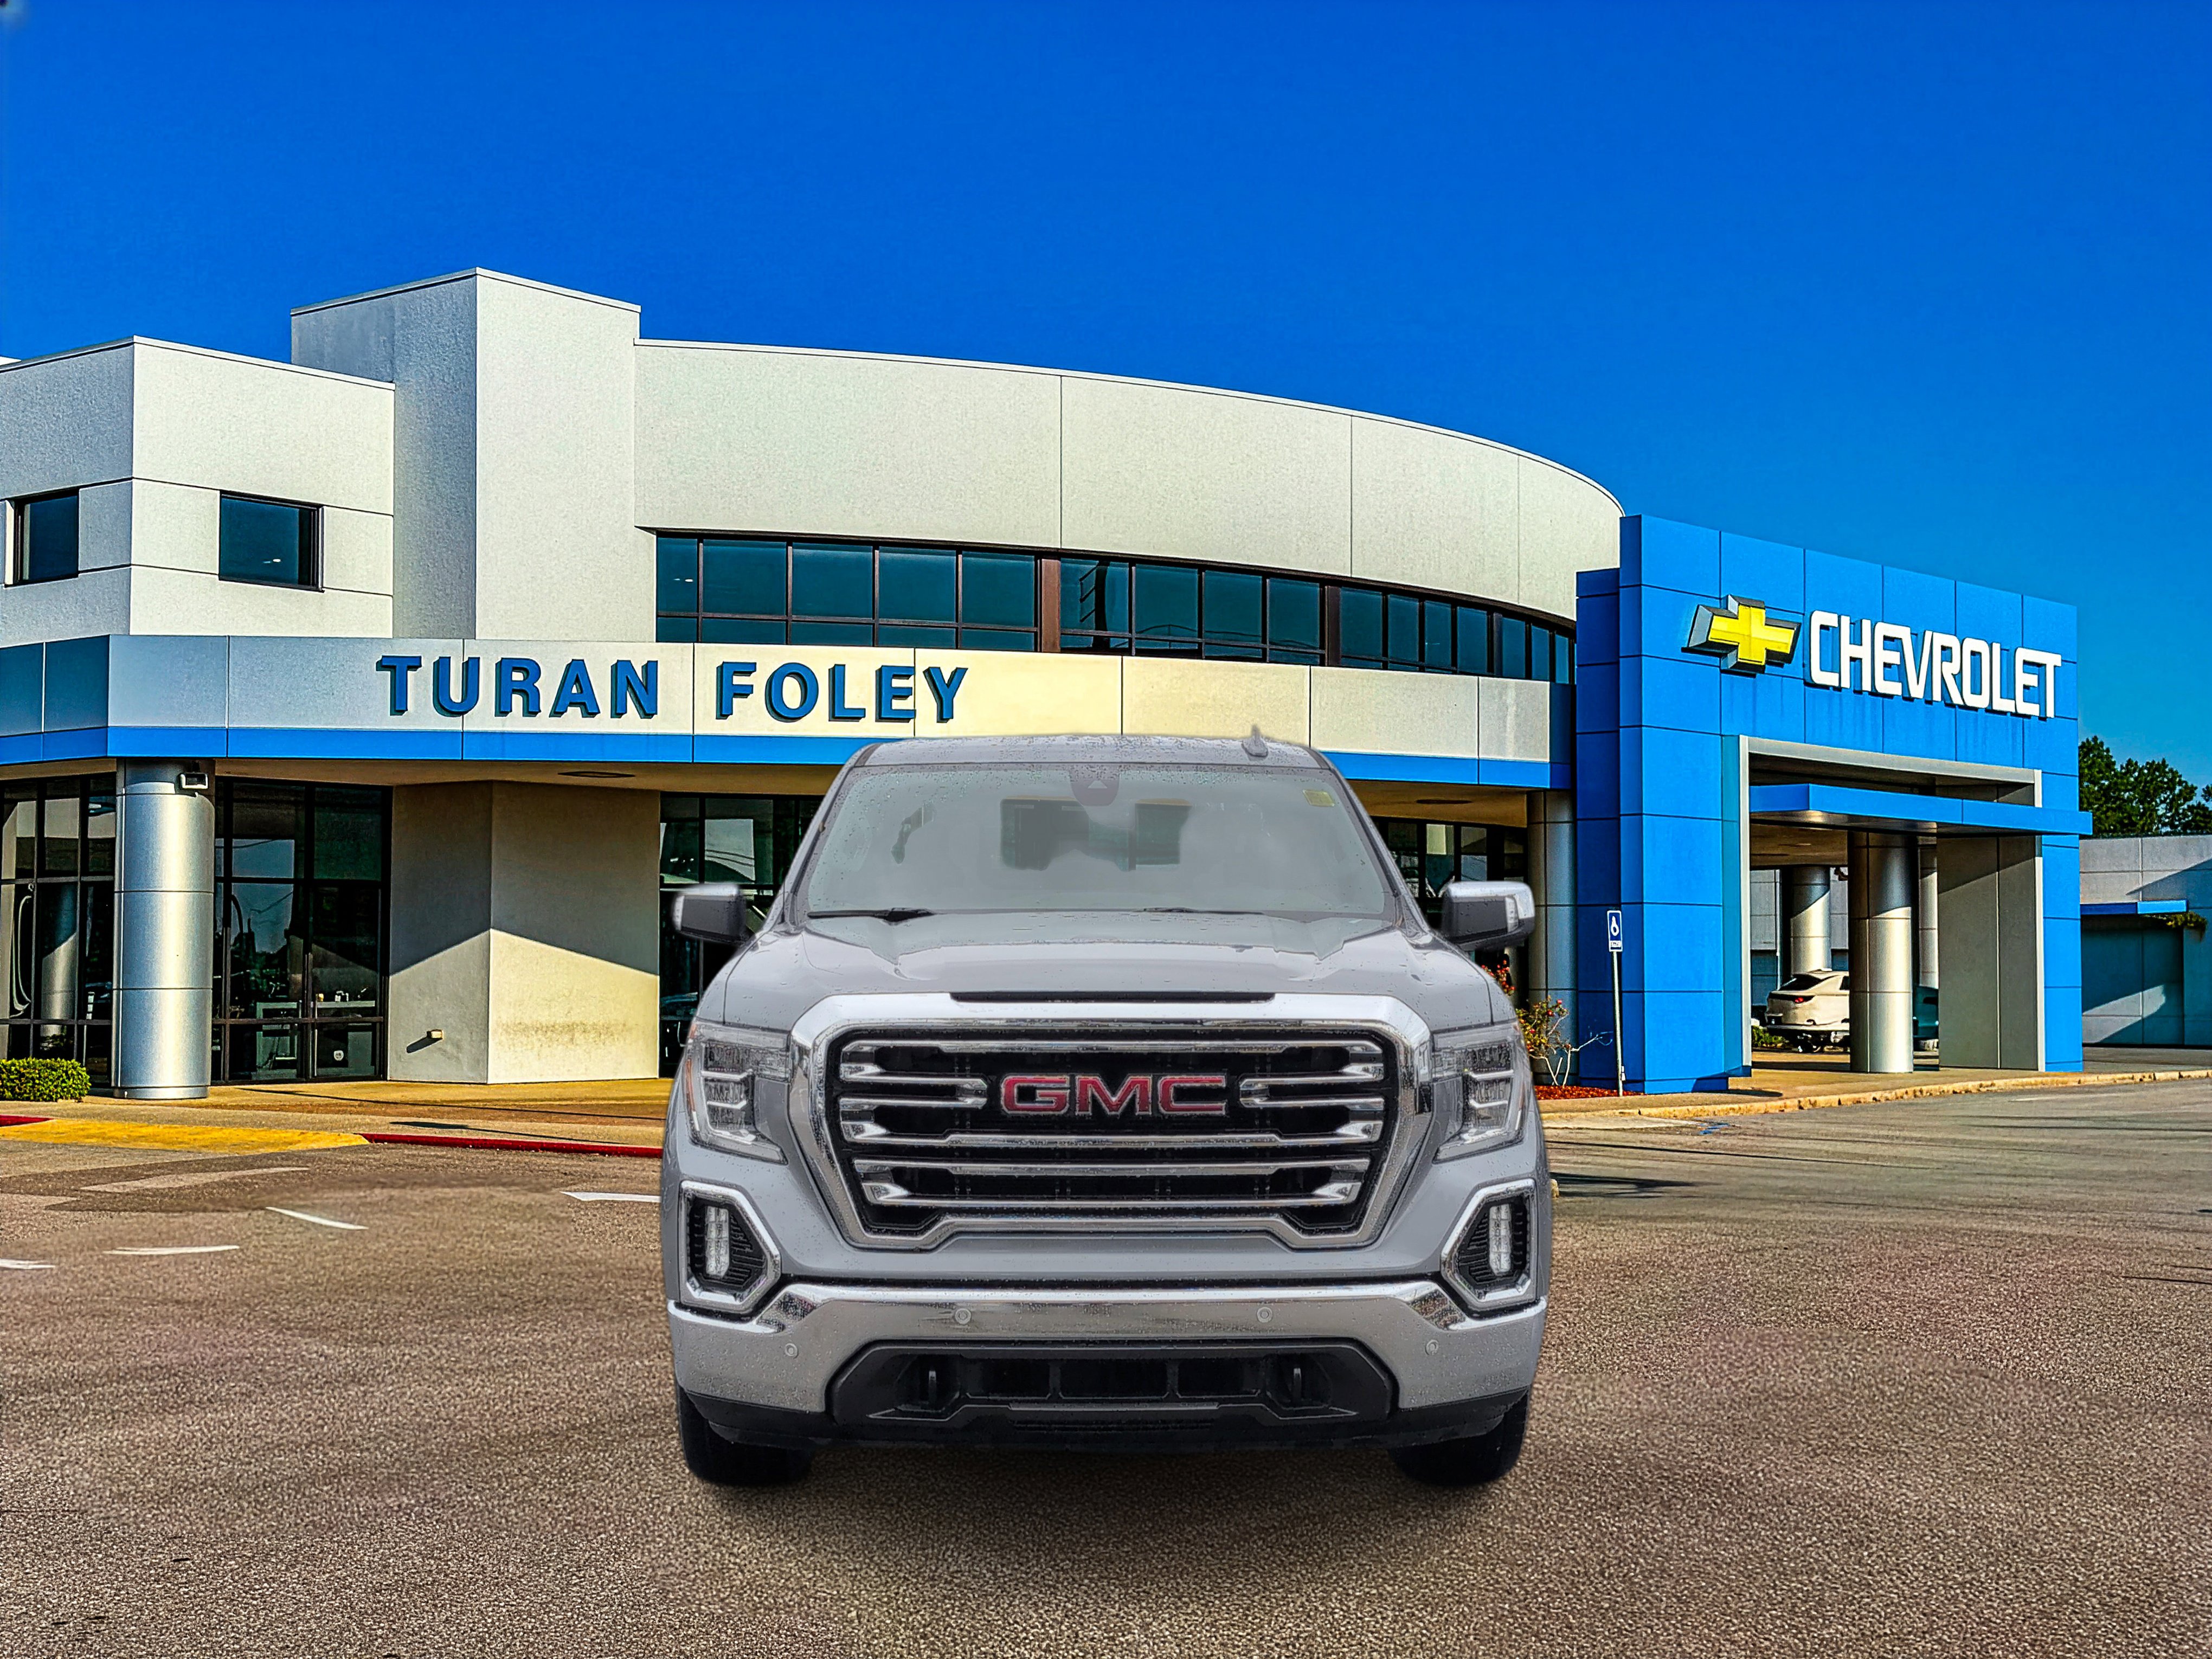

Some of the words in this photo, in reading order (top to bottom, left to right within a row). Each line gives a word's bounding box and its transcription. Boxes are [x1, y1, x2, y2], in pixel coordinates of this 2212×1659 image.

[376, 655, 658, 718] TURAN
[716, 661, 969, 723] FOLEY
[1810, 610, 2062, 718] CHEVROLET
[1000, 1075, 1227, 1115] GMC
